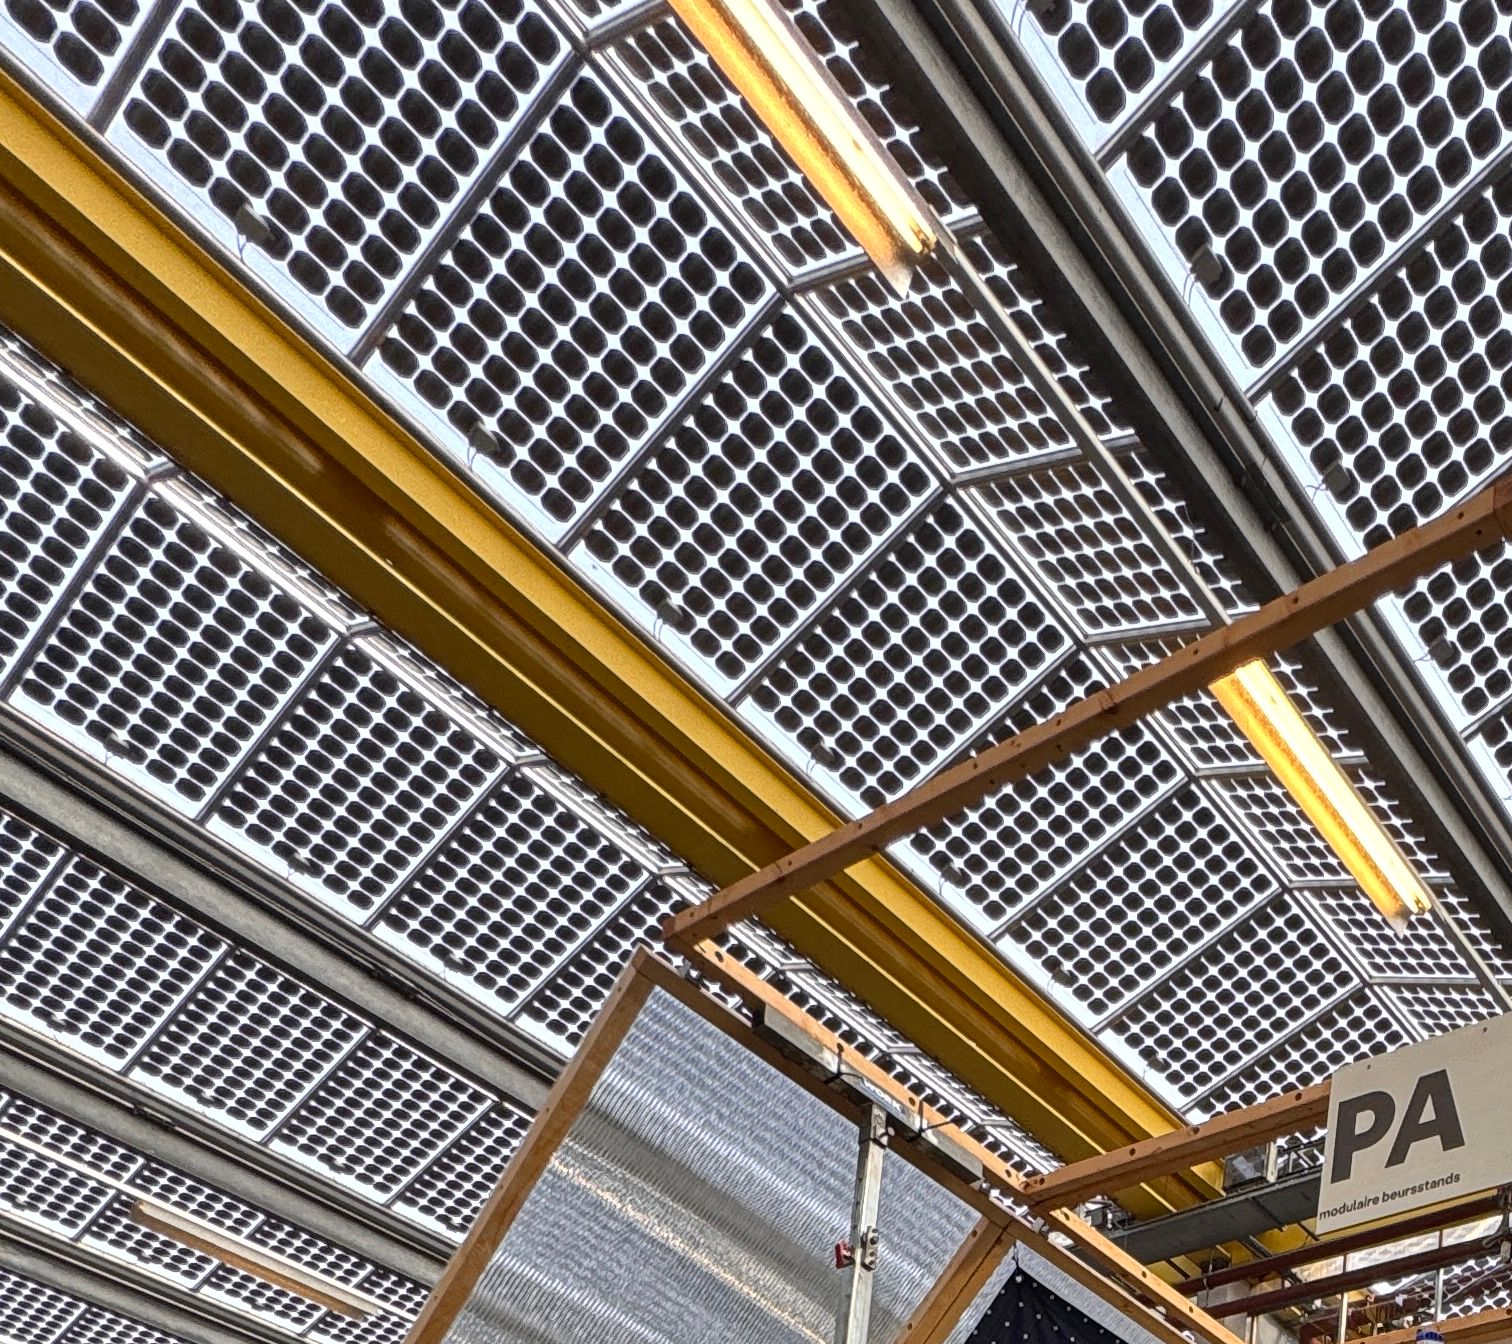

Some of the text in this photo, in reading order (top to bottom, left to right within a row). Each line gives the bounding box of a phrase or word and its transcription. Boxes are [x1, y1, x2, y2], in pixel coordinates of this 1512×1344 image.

[1331, 1069, 1465, 1184] PA
[1319, 1173, 1461, 1220] modulaire beursstands
